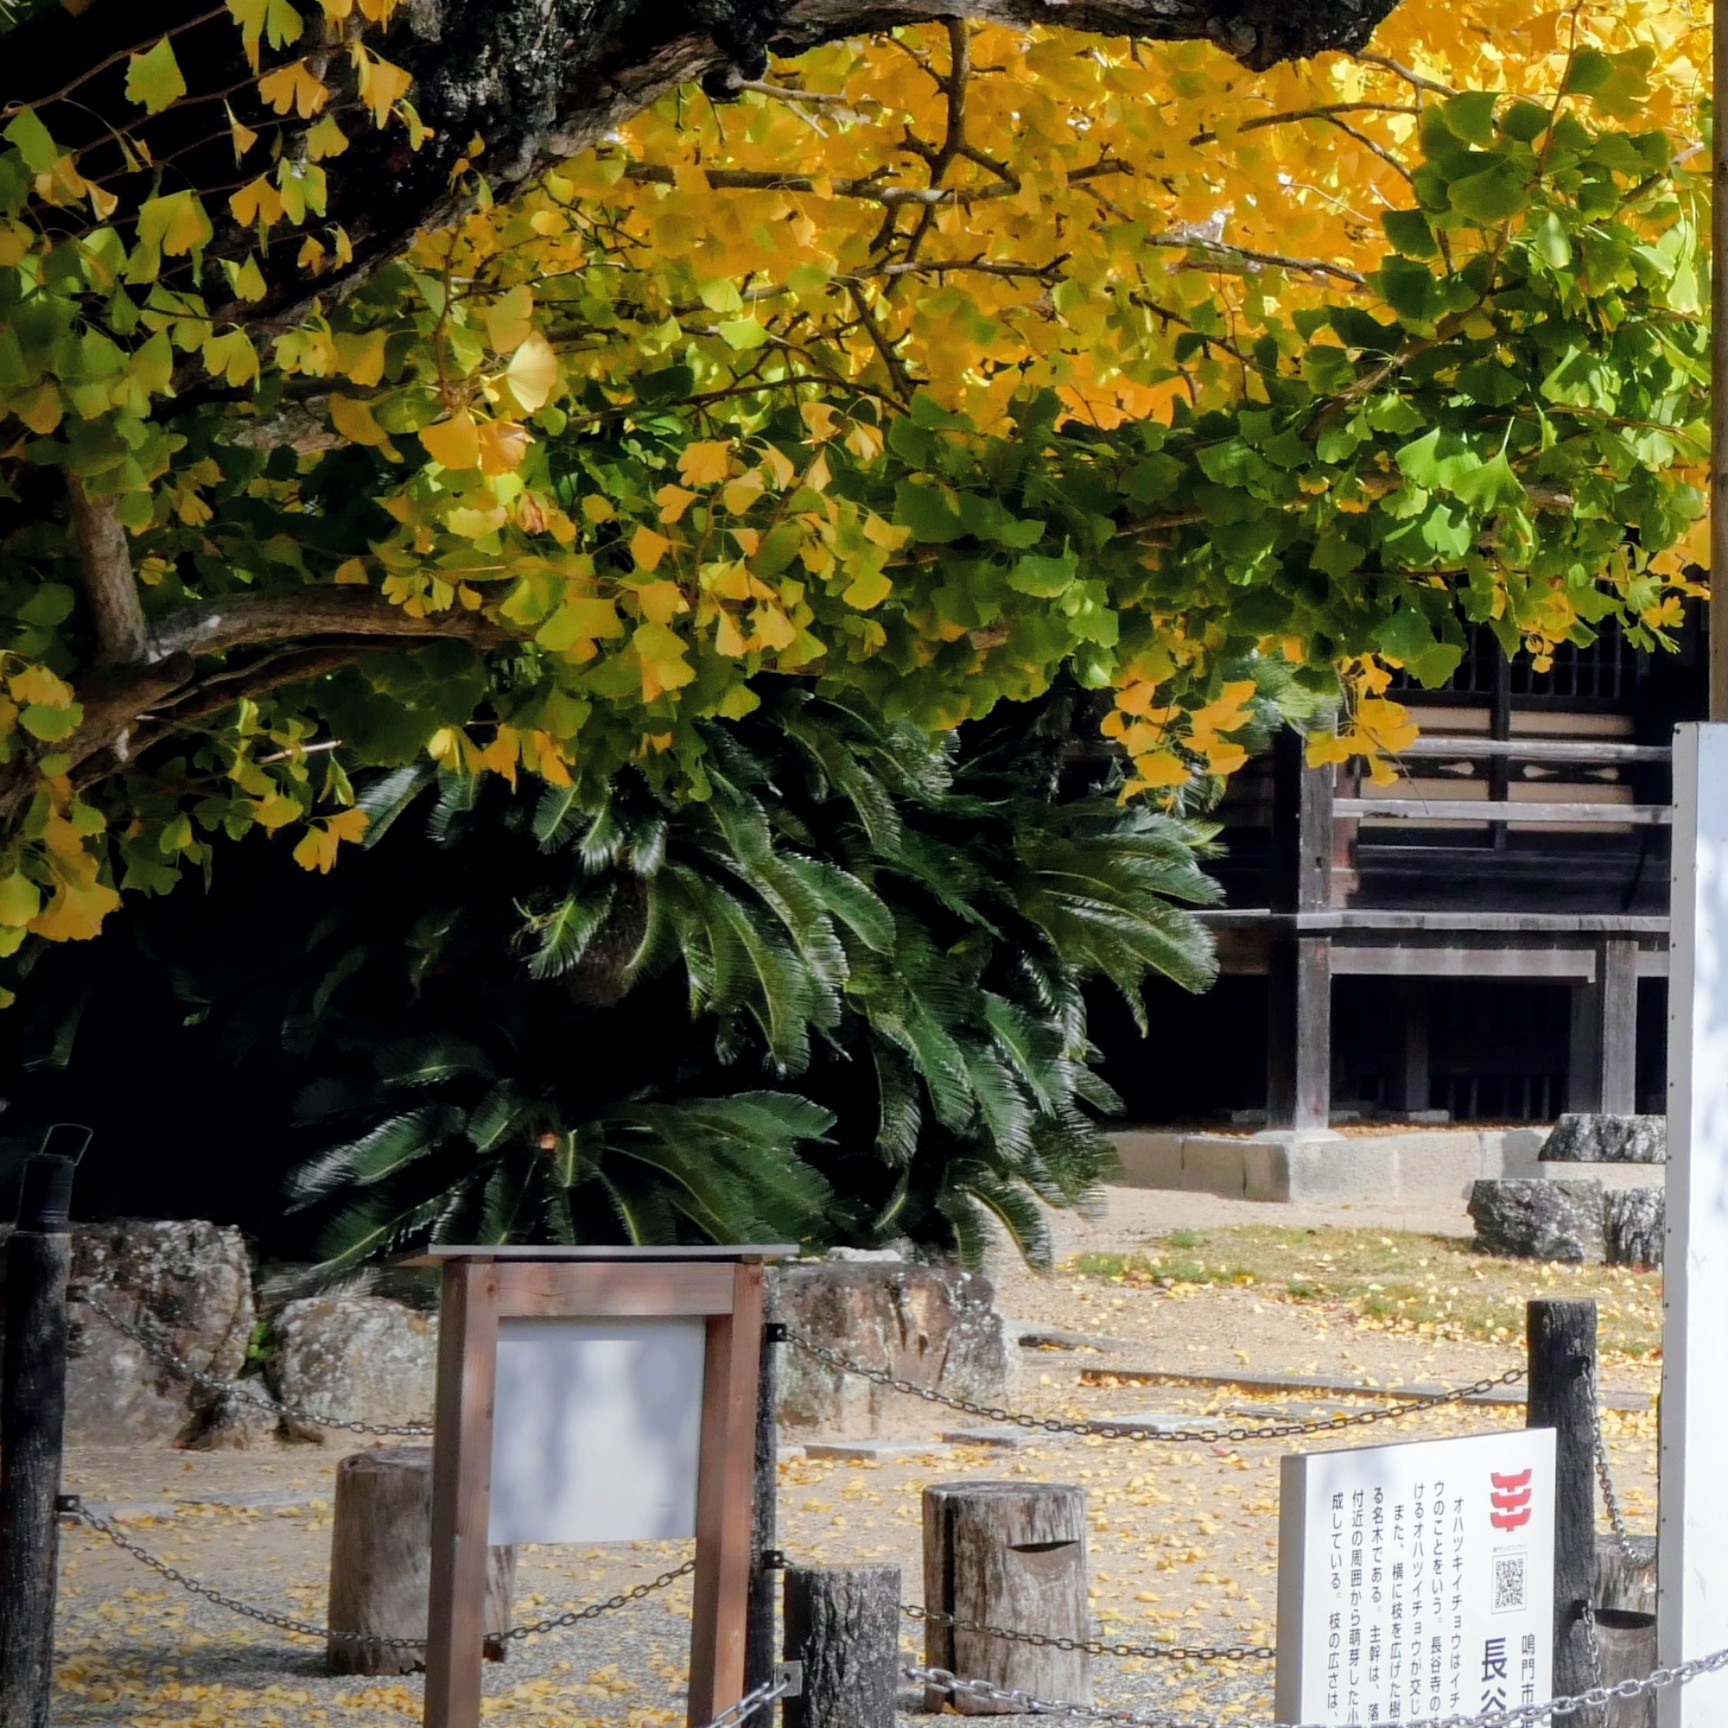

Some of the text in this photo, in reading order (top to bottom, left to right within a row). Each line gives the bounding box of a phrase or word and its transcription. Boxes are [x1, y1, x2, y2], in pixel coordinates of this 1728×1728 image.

[1389, 1504, 1406, 1722] また、横に枝を広げた樹
[1410, 1482, 1426, 1725] けるオハツイチョウが交じ
[1429, 1480, 1445, 1722] ウのことをいう。長谷寺の
[1449, 1496, 1465, 1719] オハツキイチョウはイチ
